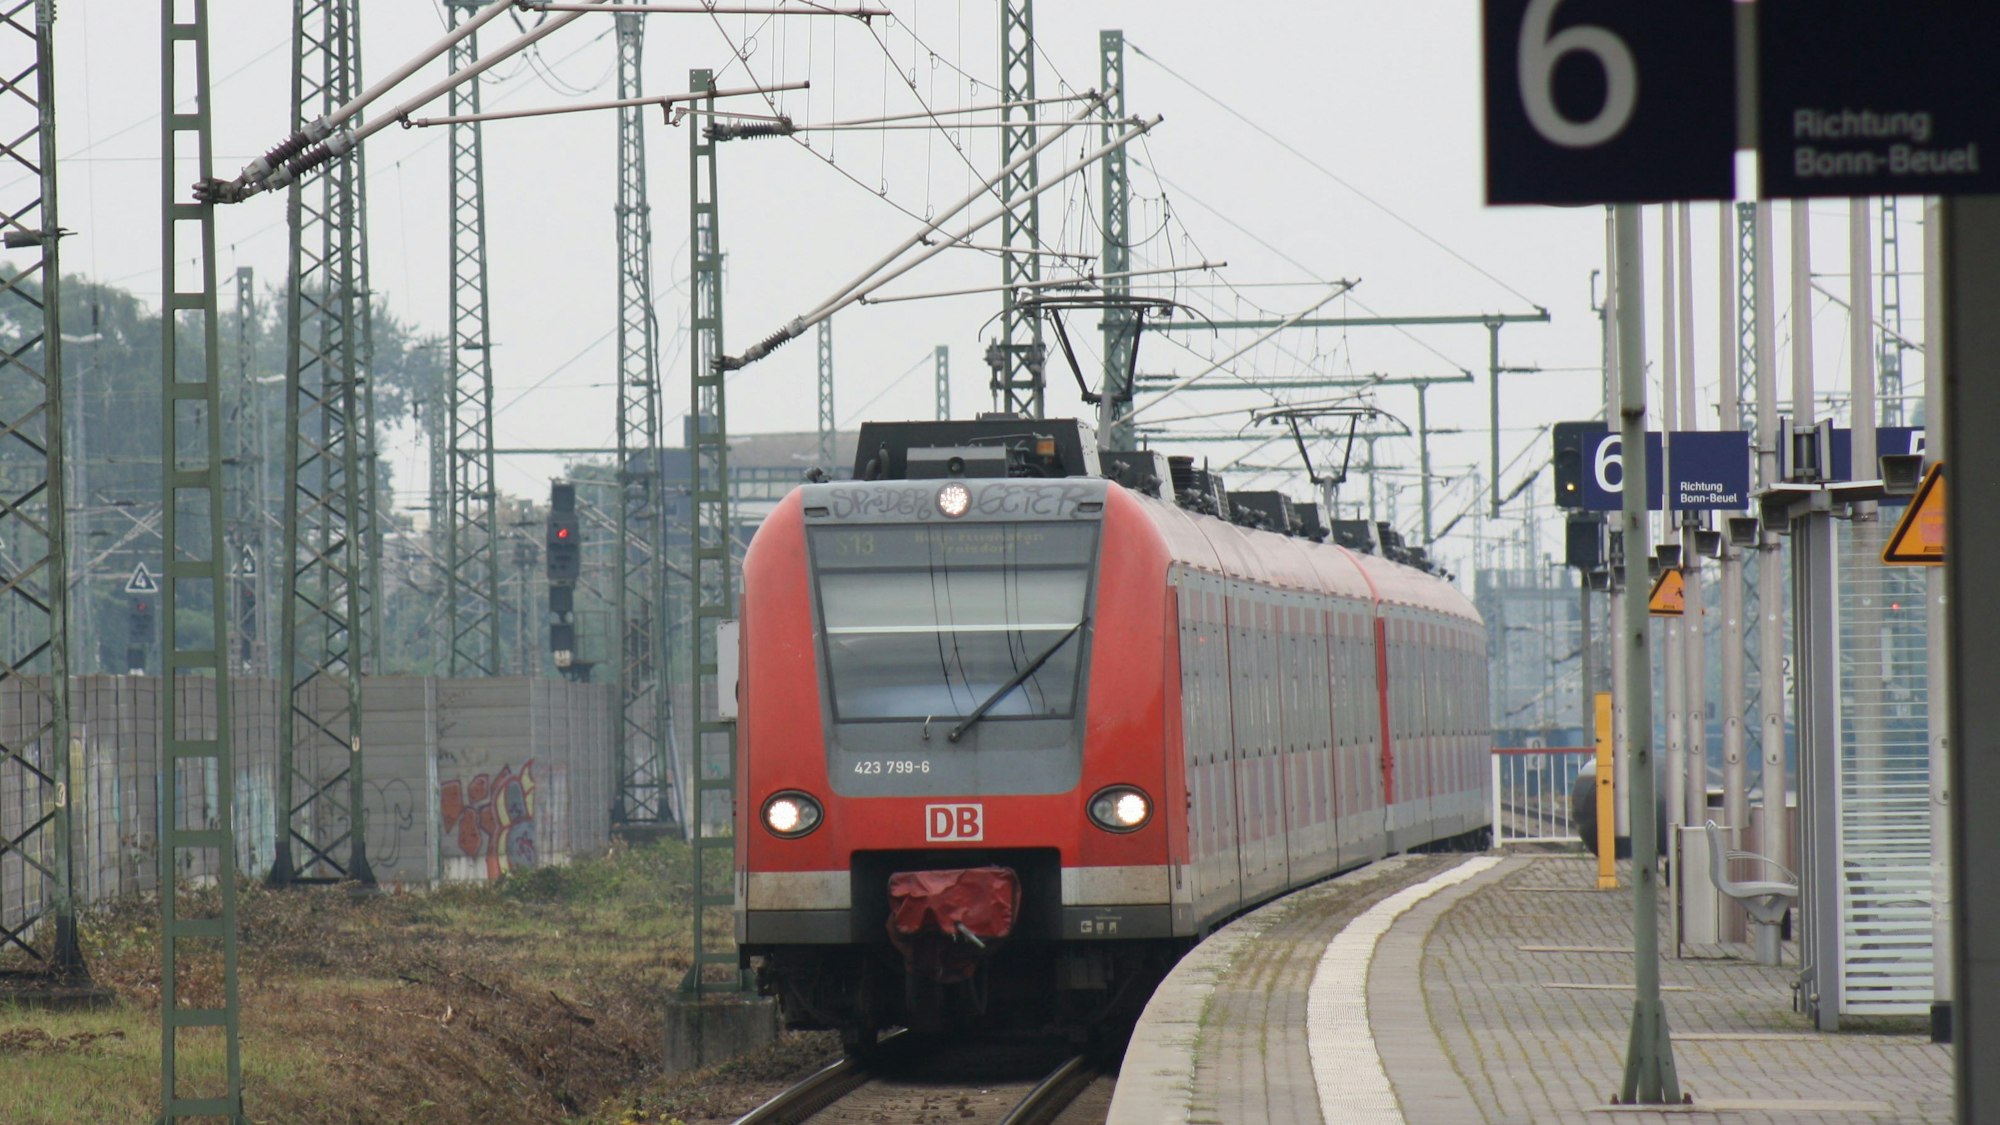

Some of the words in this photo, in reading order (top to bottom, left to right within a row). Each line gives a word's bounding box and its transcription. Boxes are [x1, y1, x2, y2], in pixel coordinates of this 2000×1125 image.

[1516, 0, 1638, 148] 6
[1794, 108, 1932, 142] Richtung
[1794, 142, 1979, 177] Bonn-Beuel
[1595, 434, 1623, 493] 6
[1680, 481, 1723, 493] Richtung
[1680, 493, 1737, 503] Bonn-Beuel
[854, 761, 881, 774] 423
[887, 760, 930, 774] 799-6
[930, 806, 980, 838] DB
